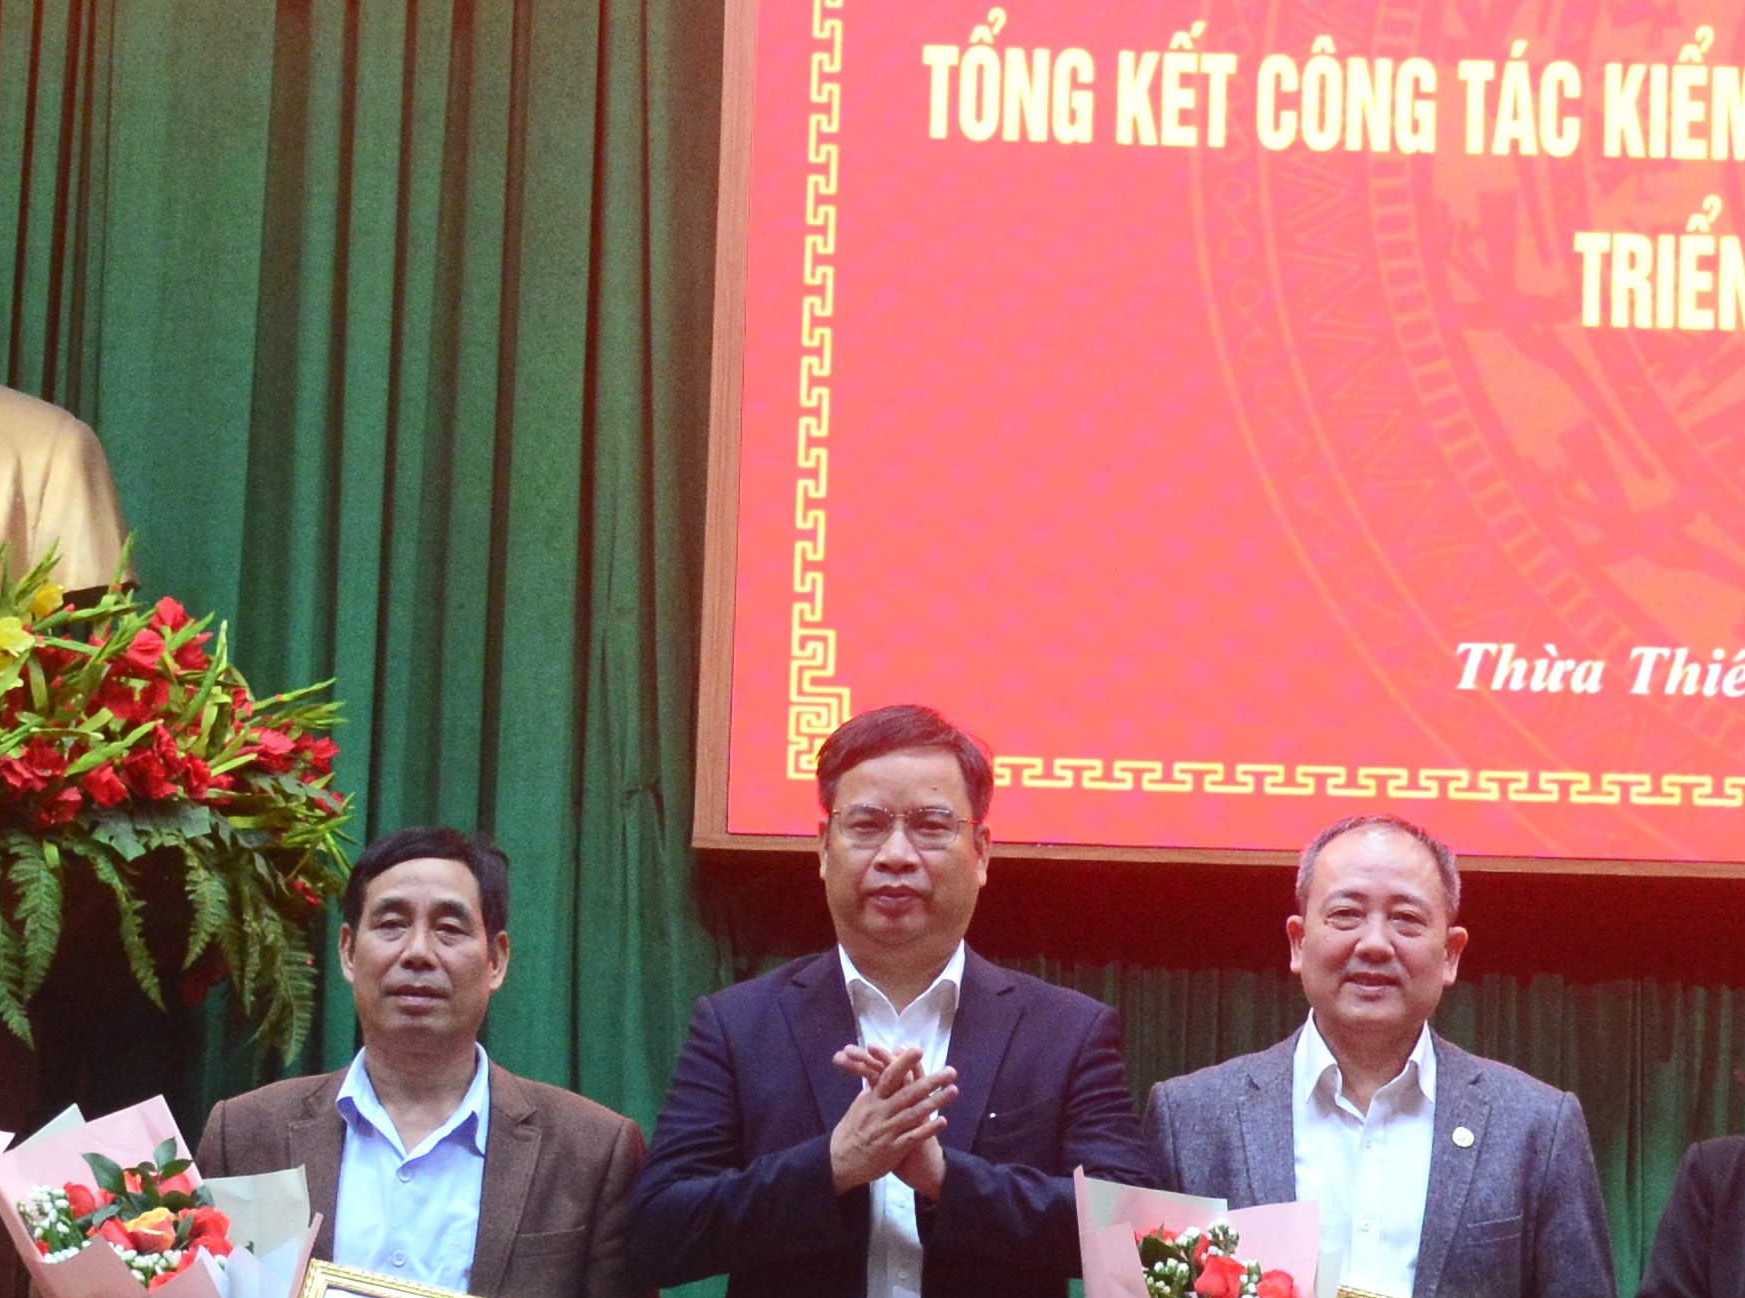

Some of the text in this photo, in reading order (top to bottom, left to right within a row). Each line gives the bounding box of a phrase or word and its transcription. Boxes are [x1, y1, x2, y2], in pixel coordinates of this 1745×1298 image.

[923, 8, 1094, 144] TỔNG
[1116, 21, 1237, 147] KẾT
[1257, 35, 1437, 154] CÔNG
[1458, 40, 1581, 157] TÁC
[1456, 642, 1606, 694] Thừa
